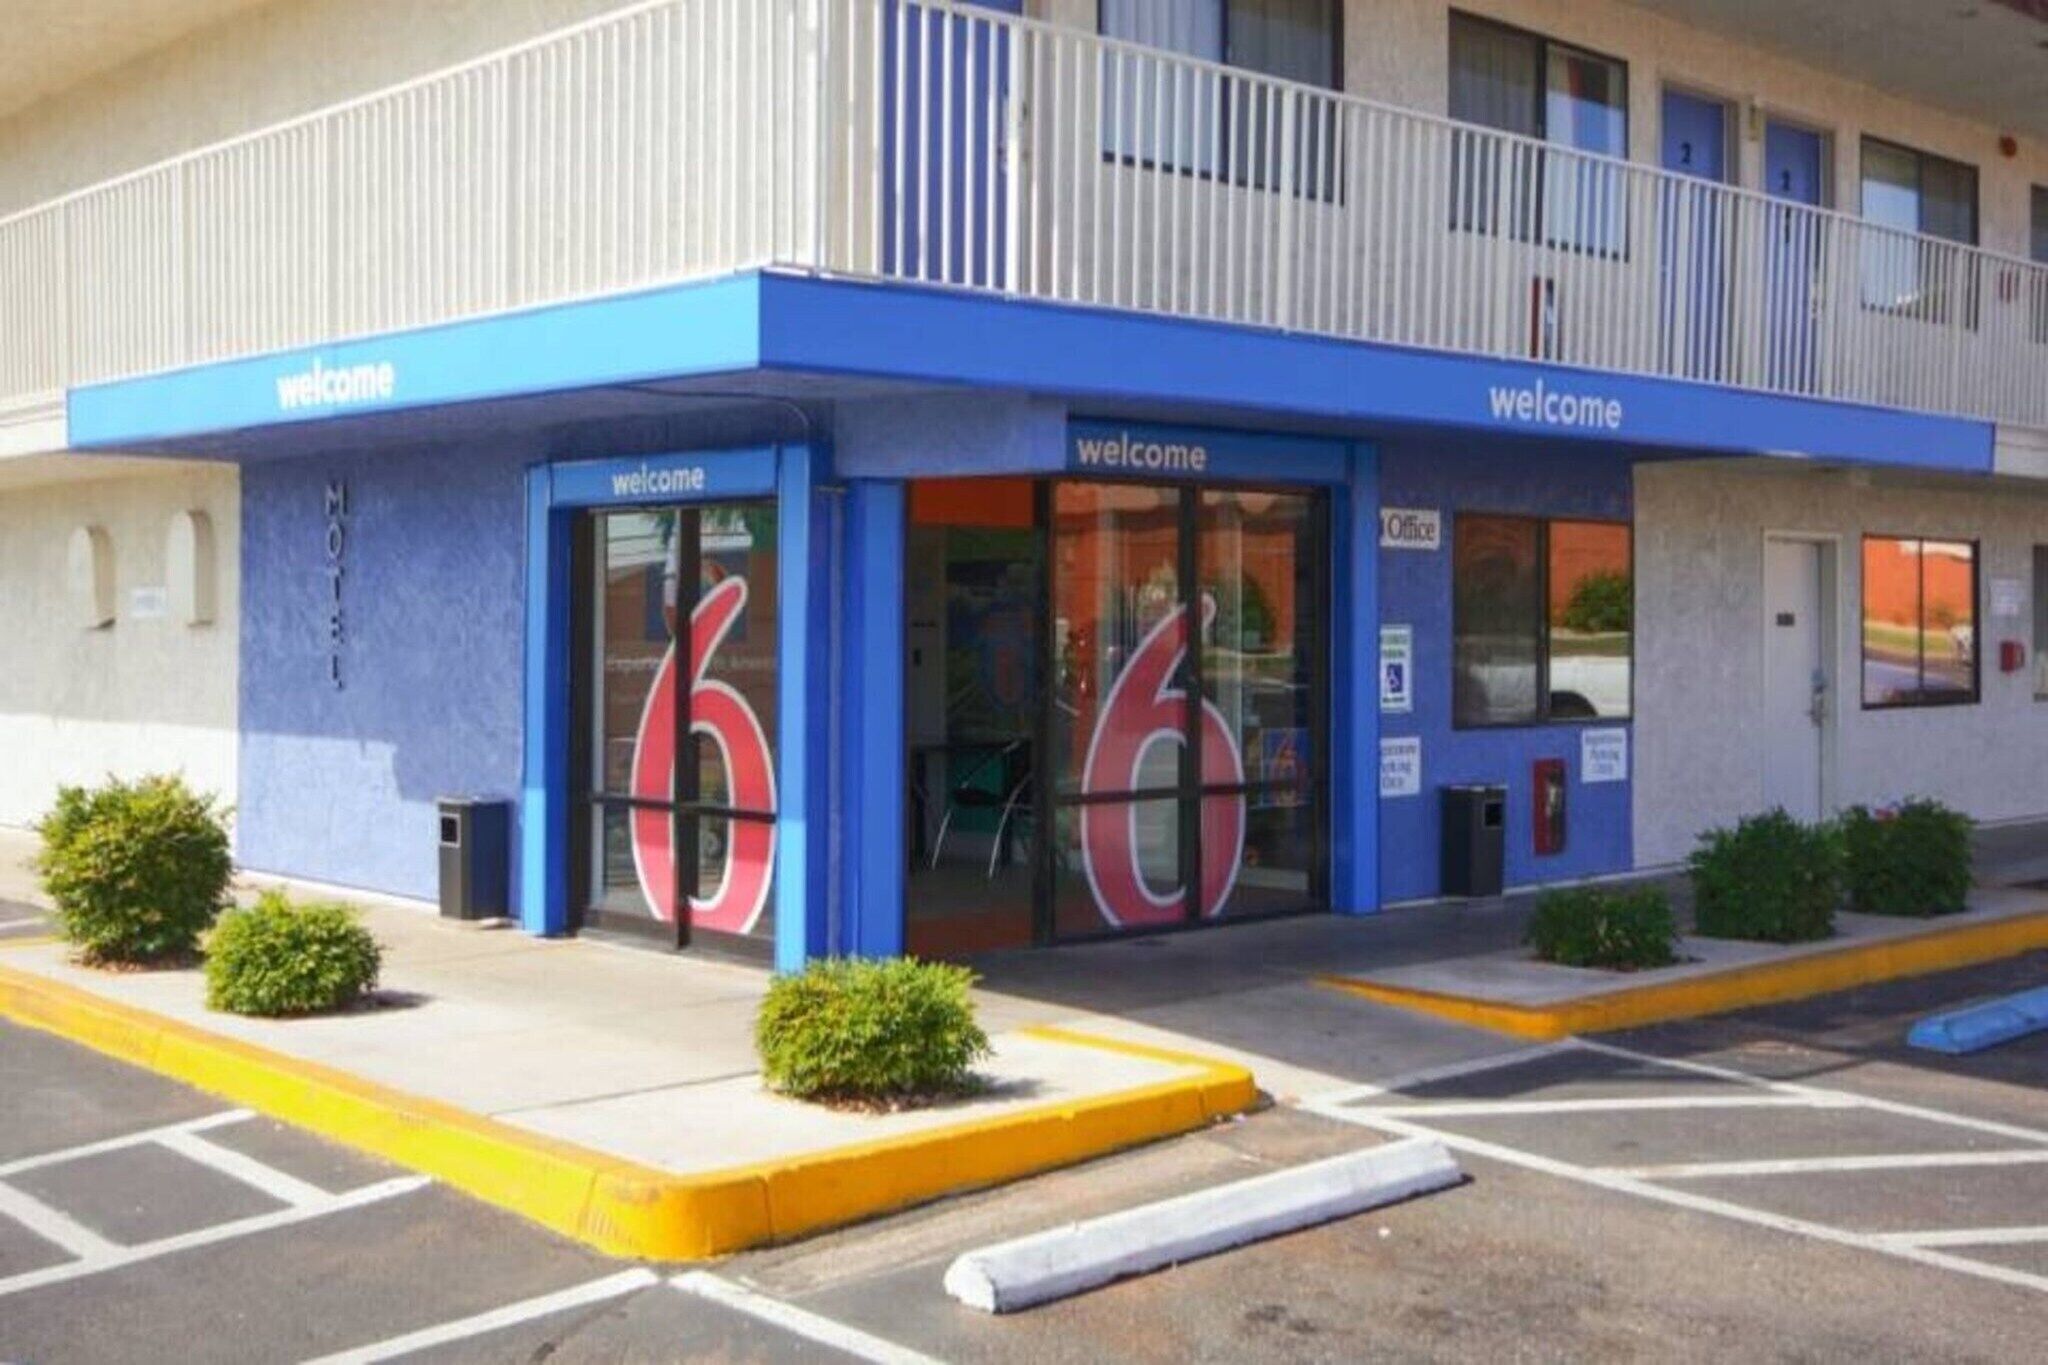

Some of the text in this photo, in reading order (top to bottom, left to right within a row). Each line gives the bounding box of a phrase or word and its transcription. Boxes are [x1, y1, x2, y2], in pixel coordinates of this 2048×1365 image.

[276, 358, 394, 410] welcome
[1489, 378, 1621, 428] welcome
[1077, 430, 1206, 471] welcome
[612, 462, 704, 496] welcome
[1386, 513, 1435, 541] Office
[630, 575, 776, 934] 6
[1080, 592, 1246, 930] 6
